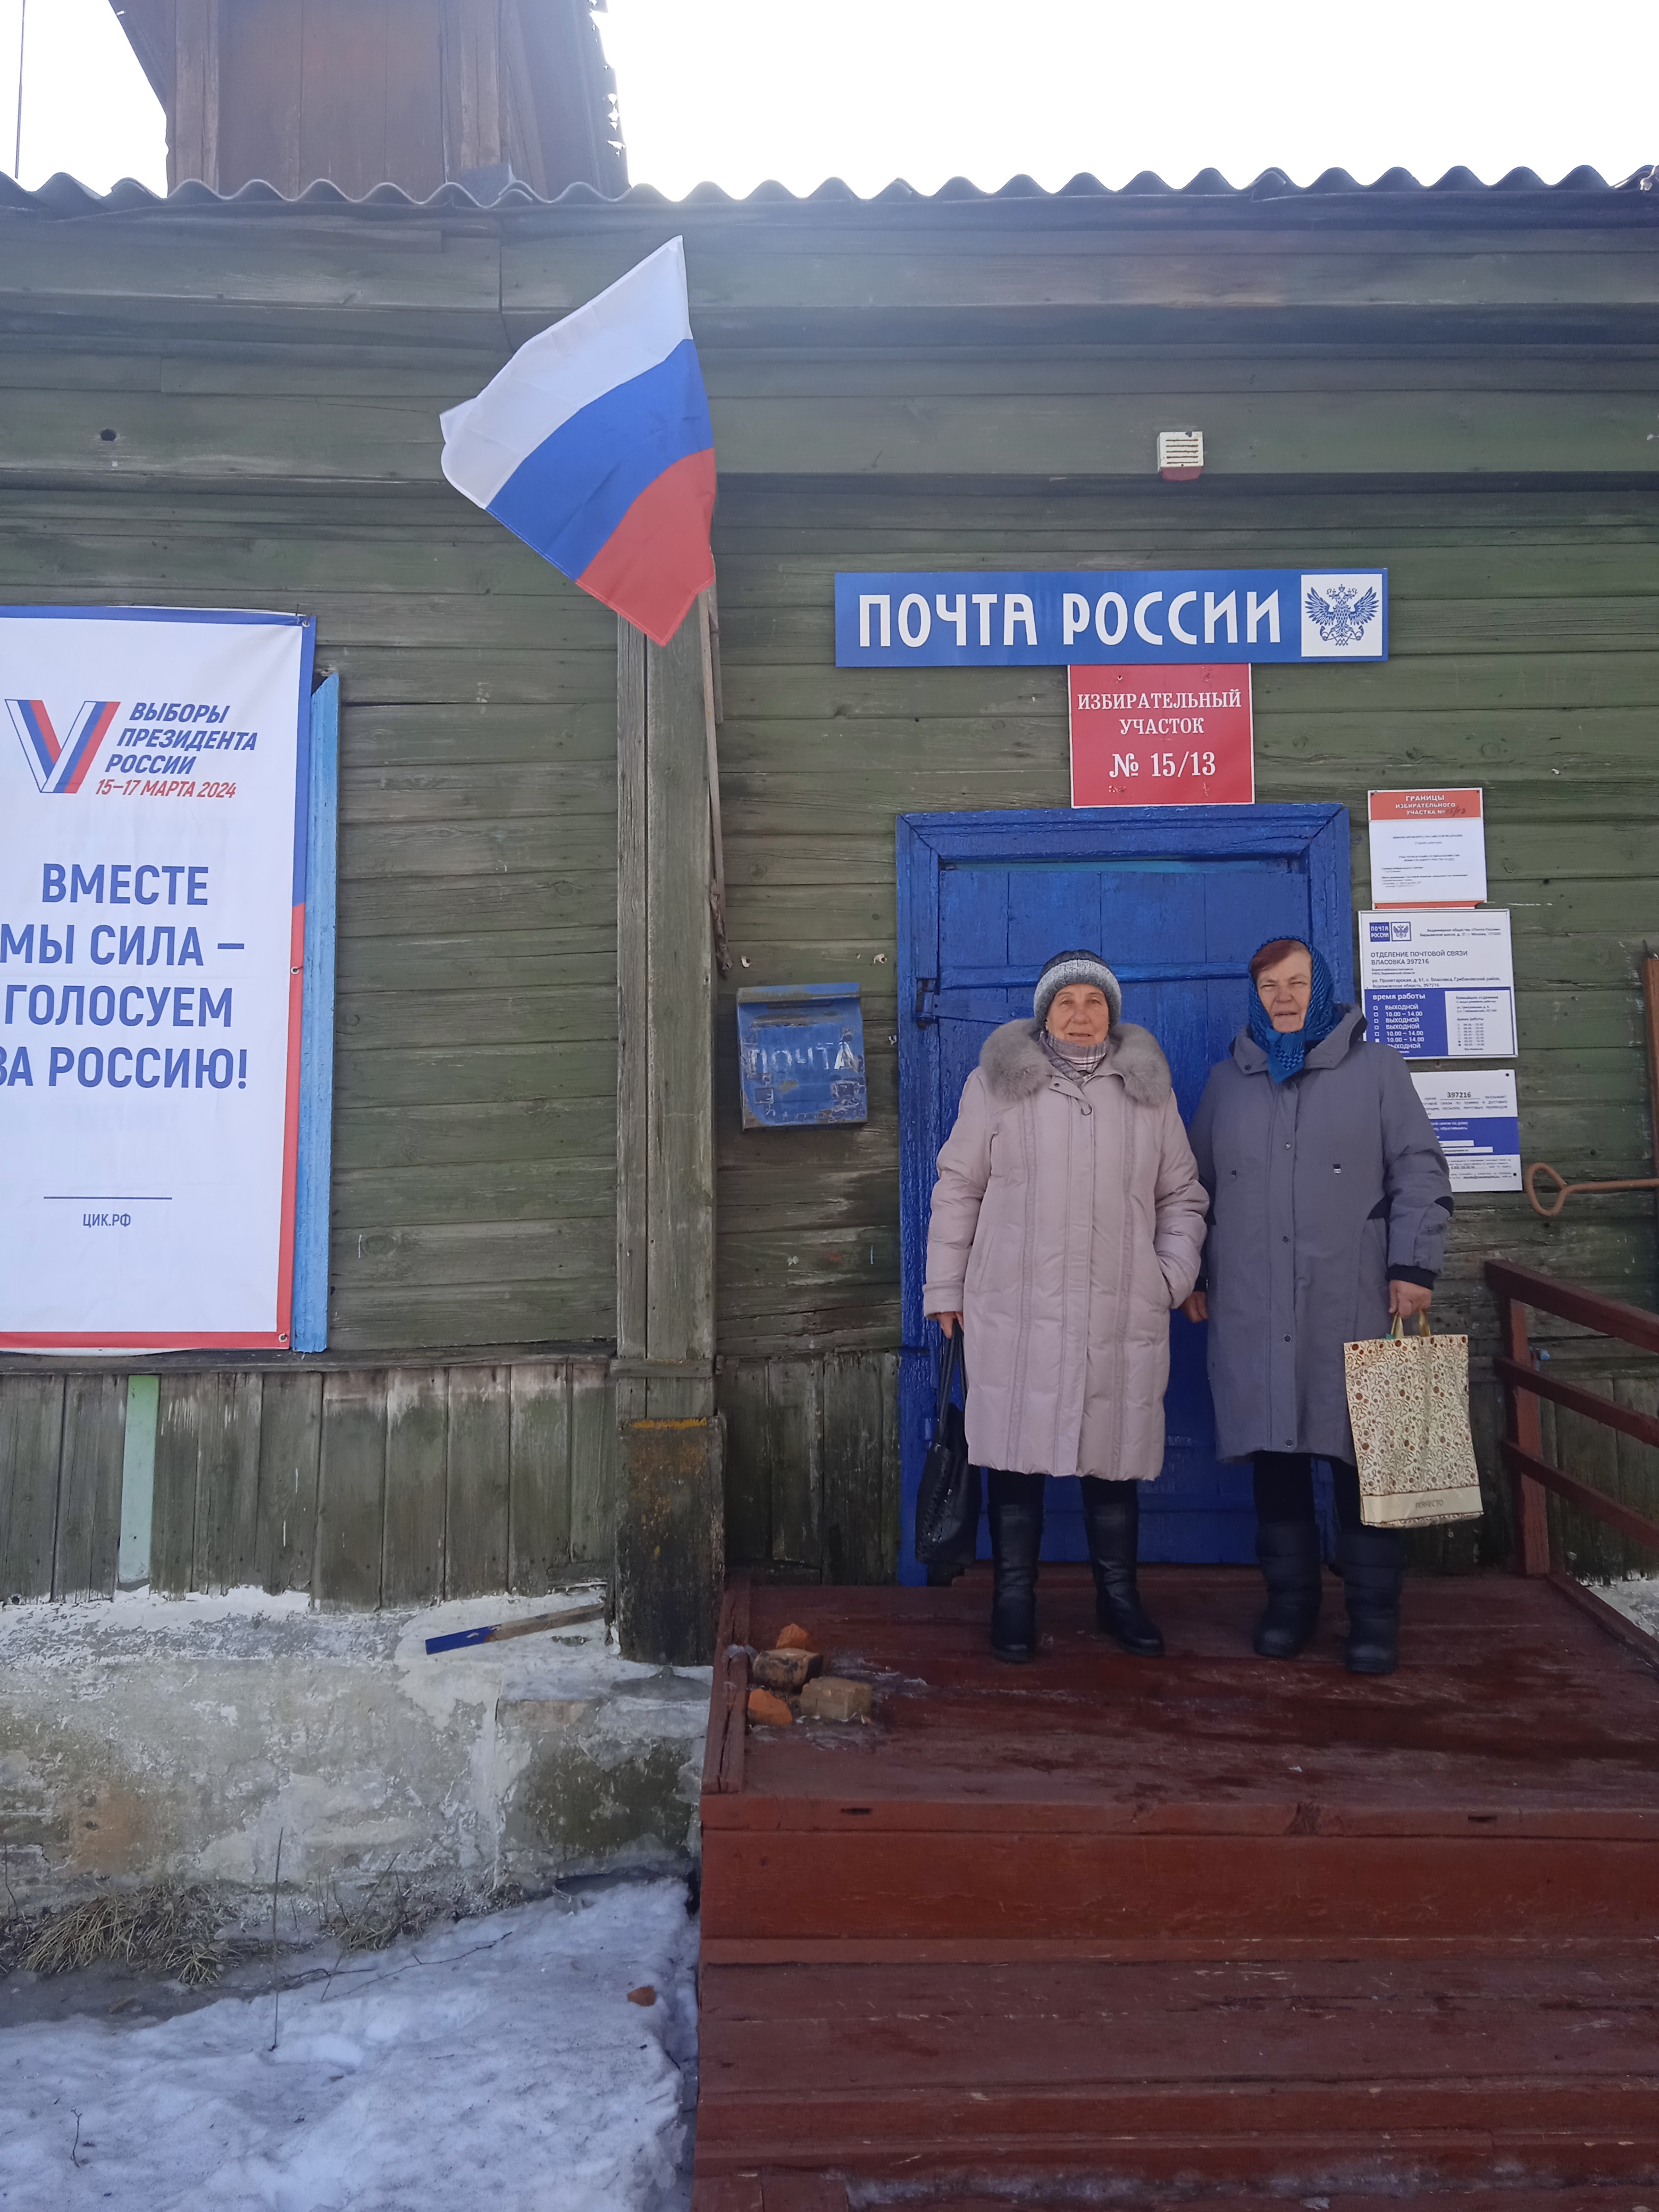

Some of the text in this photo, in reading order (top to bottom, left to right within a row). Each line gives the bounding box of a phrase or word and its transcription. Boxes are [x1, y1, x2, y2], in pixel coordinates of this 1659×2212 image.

[859, 588, 1280, 648] ПОЧТА РОССИИ
[1077, 688, 1242, 710] ИЗБИРАТЕЛЬНЫЙ
[129, 702, 230, 724] ВЫБОРЫ
[1119, 717, 1204, 736] УЧАСТОК
[117, 727, 258, 751] ПРЕЗИДЕНТА
[105, 753, 197, 774] РОССИИ
[1109, 751, 1217, 778] № 15/13
[140, 780, 196, 798] МАРТА
[197, 782, 237, 798] 2024
[42, 863, 208, 905] ВМЕСТЕ
[0, 924, 74, 964] МЫ
[90, 925, 204, 966] СИЛА
[5, 984, 232, 1027] ГОЛОСУЕМ
[48, 1046, 247, 1090] РОССИЮ!
[82, 1213, 131, 1228] ЦИК.РФ
